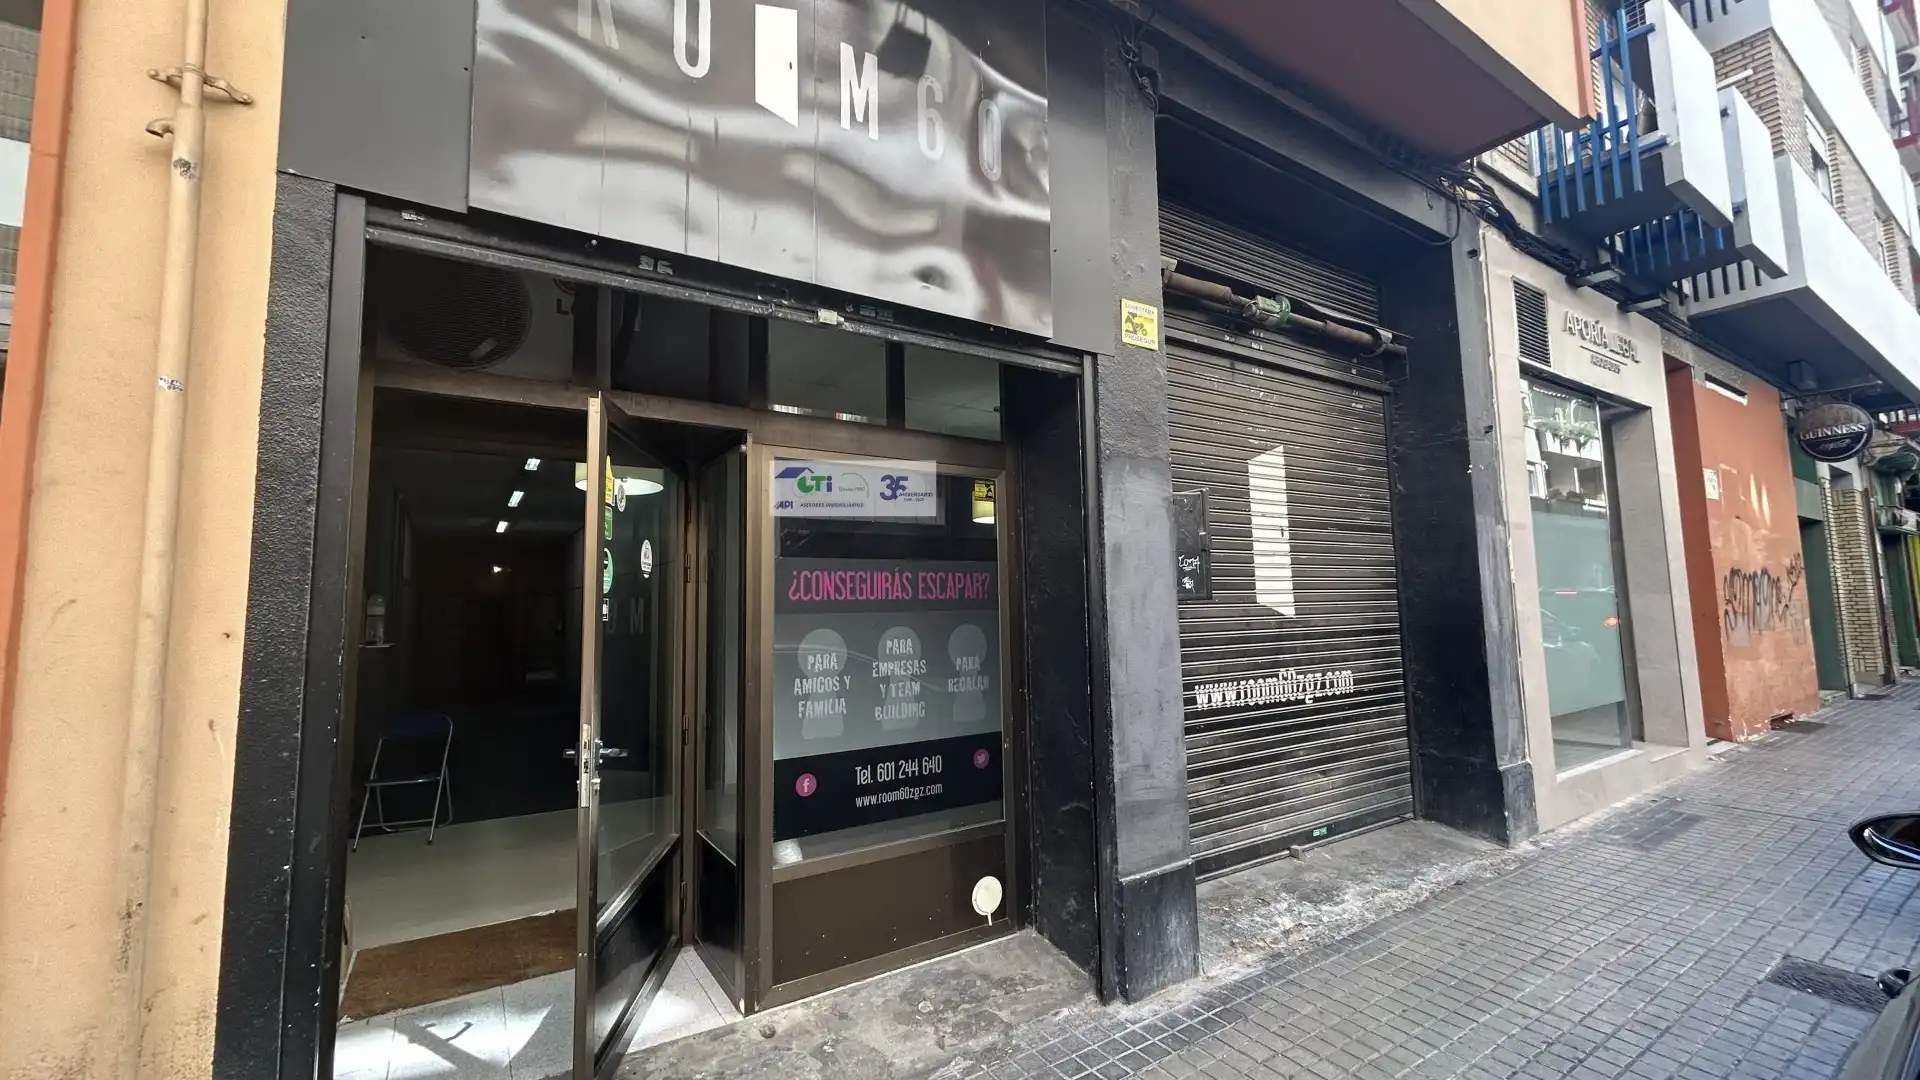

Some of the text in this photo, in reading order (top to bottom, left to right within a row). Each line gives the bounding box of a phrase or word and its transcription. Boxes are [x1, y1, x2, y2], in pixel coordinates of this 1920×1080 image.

[1563, 309, 1609, 349] APORÍA
[1800, 422, 1867, 440] GUINNESS
[788, 566, 990, 602] ¿CONSEGUIRÁS ESCAPAR?
[885, 637, 914, 656] PARA
[807, 652, 838, 672] PARA
[872, 659, 927, 678] EMPRESAS
[956, 655, 981, 672] PARA
[793, 675, 851, 696] AMIGOS Y
[879, 682, 921, 699] Y TEAM
[948, 674, 990, 693] REGALAR
[1194, 668, 1354, 711] www.room60zgz.com
[798, 698, 847, 719] FAMILIA
[874, 702, 926, 722] BUILDING
[855, 755, 943, 786] Tel. 601 244 640
[855, 782, 943, 809] www.room60zgz.com
